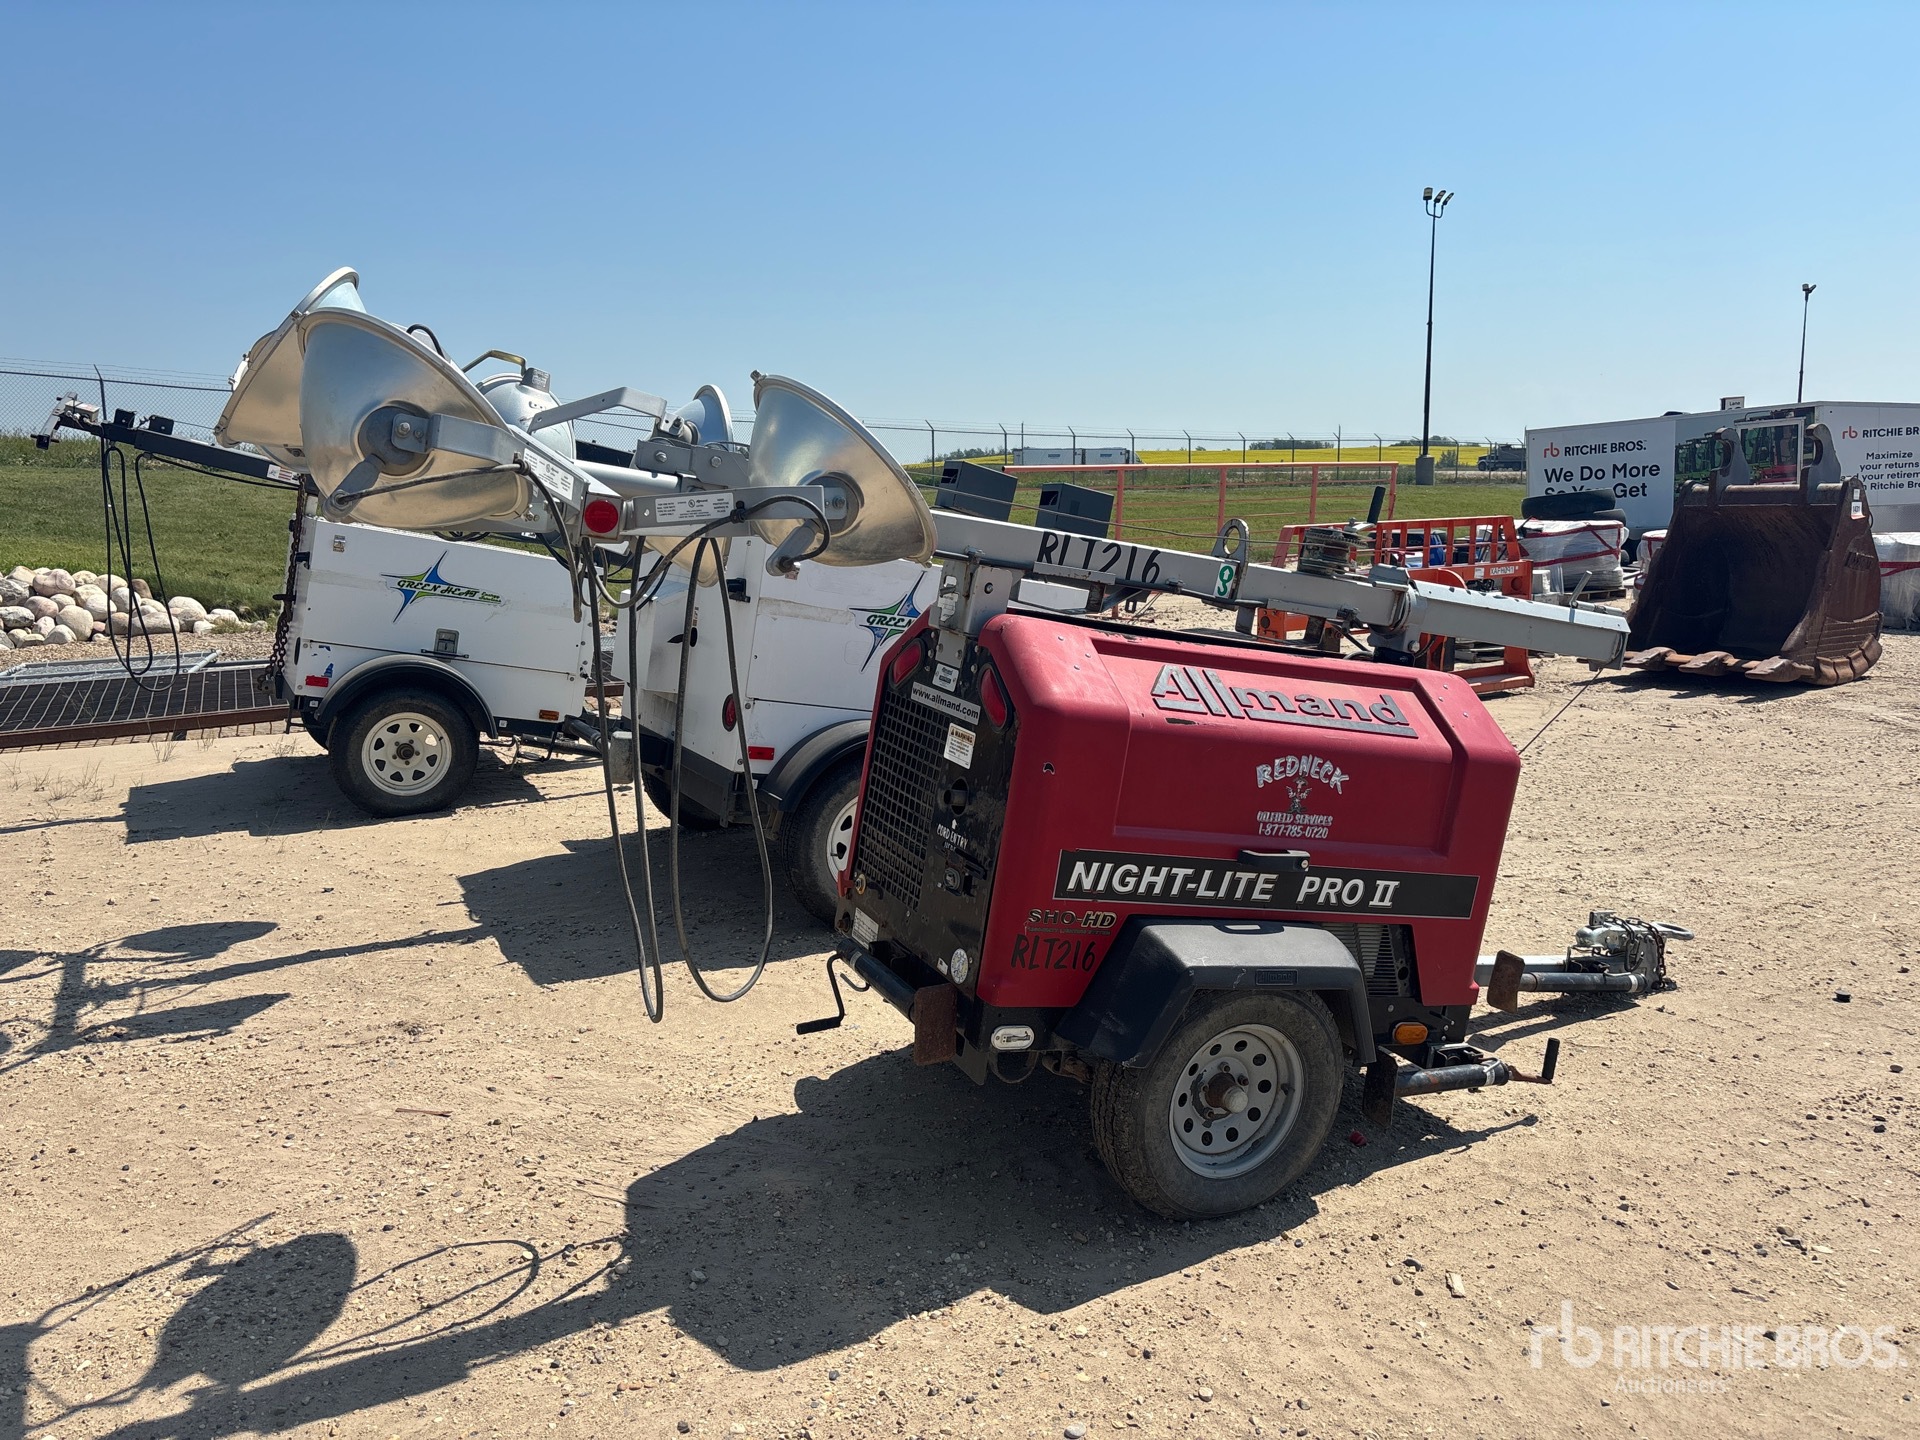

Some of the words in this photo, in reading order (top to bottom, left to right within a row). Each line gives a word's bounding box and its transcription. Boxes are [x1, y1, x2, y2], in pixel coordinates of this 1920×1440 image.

[1842, 425, 1858, 439] rb
[1862, 427, 1904, 438] RITCHIE
[1543, 442, 1560, 458] rb
[1564, 443, 1608, 457] RITCHIE
[1866, 450, 1914, 460] Maximize
[1544, 467, 1574, 483] We
[1580, 465, 1606, 481] Do
[1612, 463, 1661, 479] More
[1860, 463, 1883, 472] your
[1885, 461, 1920, 470] returns
[1862, 473, 1885, 483] your
[1870, 480, 1905, 491] Ritchie
[1612, 482, 1648, 498] Get
[397, 580, 441, 592] GREEN
[912, 687, 979, 719] www.allmand.com
[1150, 664, 1410, 726] Allmand
[1256, 754, 1350, 794] REDNECK
[1294, 814, 1334, 827] SERVICES
[1067, 861, 1280, 901] NIGHT-LITE
[1296, 875, 1366, 906] PRO
[1368, 880, 1401, 908] II
[1028, 908, 1117, 929] SHO-HD
[1010, 933, 1097, 972] RLT216
